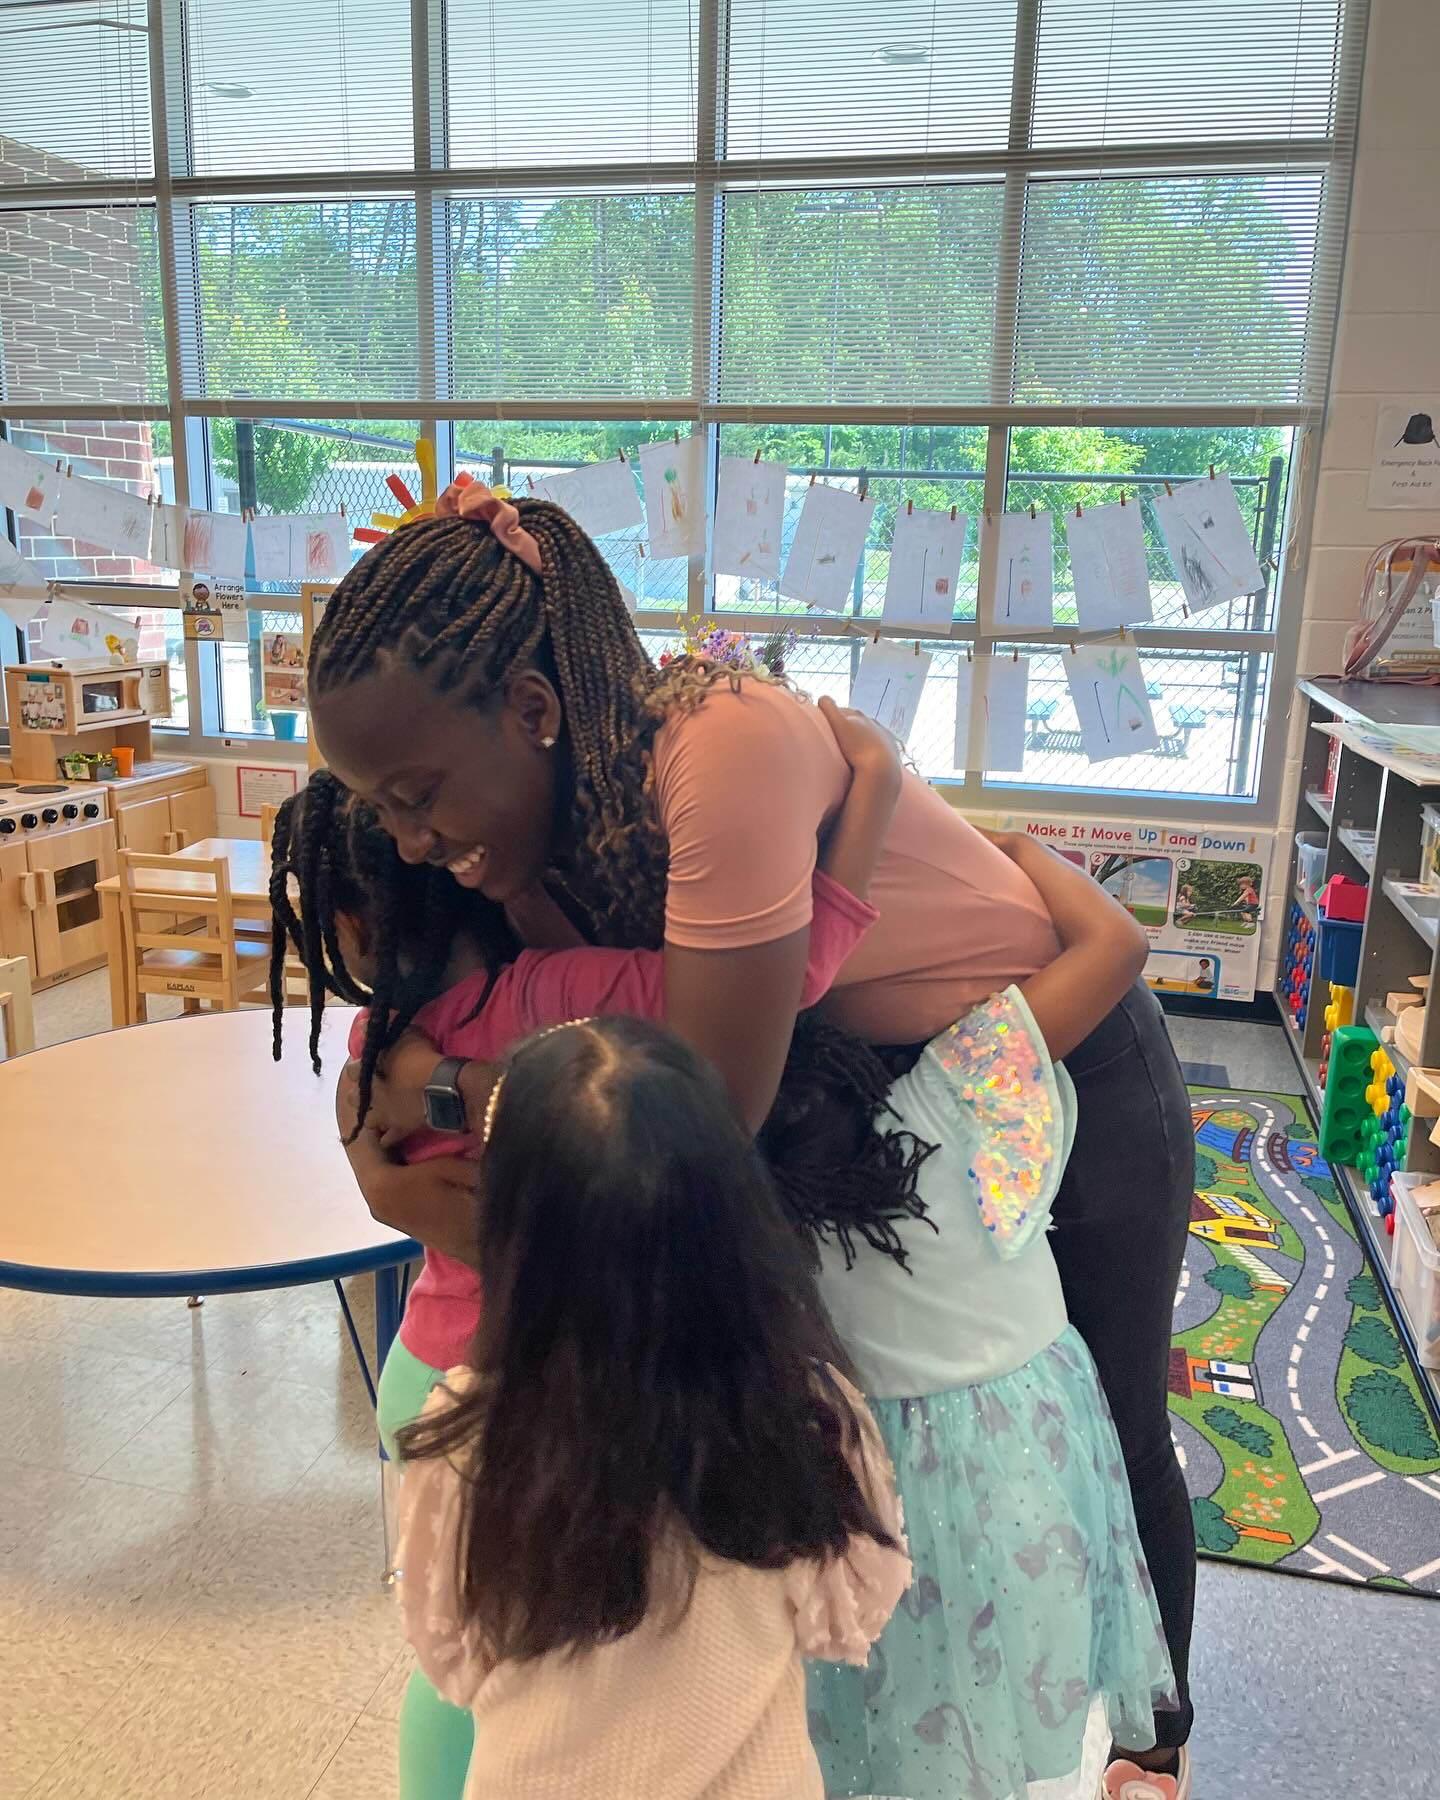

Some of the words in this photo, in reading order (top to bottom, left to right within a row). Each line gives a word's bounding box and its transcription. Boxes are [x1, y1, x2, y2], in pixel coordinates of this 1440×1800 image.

[214, 583, 245, 593] Arrange
[215, 593, 244, 601] Flowers
[221, 601, 240, 610] Here
[1026, 823, 1067, 838] Make
[1071, 825, 1086, 839] It
[1091, 827, 1132, 841] Move
[1138, 828, 1157, 844] Up
[1169, 834, 1198, 847] and
[1202, 837, 1246, 851] Down
[1093, 854, 1102, 864] 2
[1180, 860, 1187, 869] 3
[166, 983, 196, 992] KAPLAN
